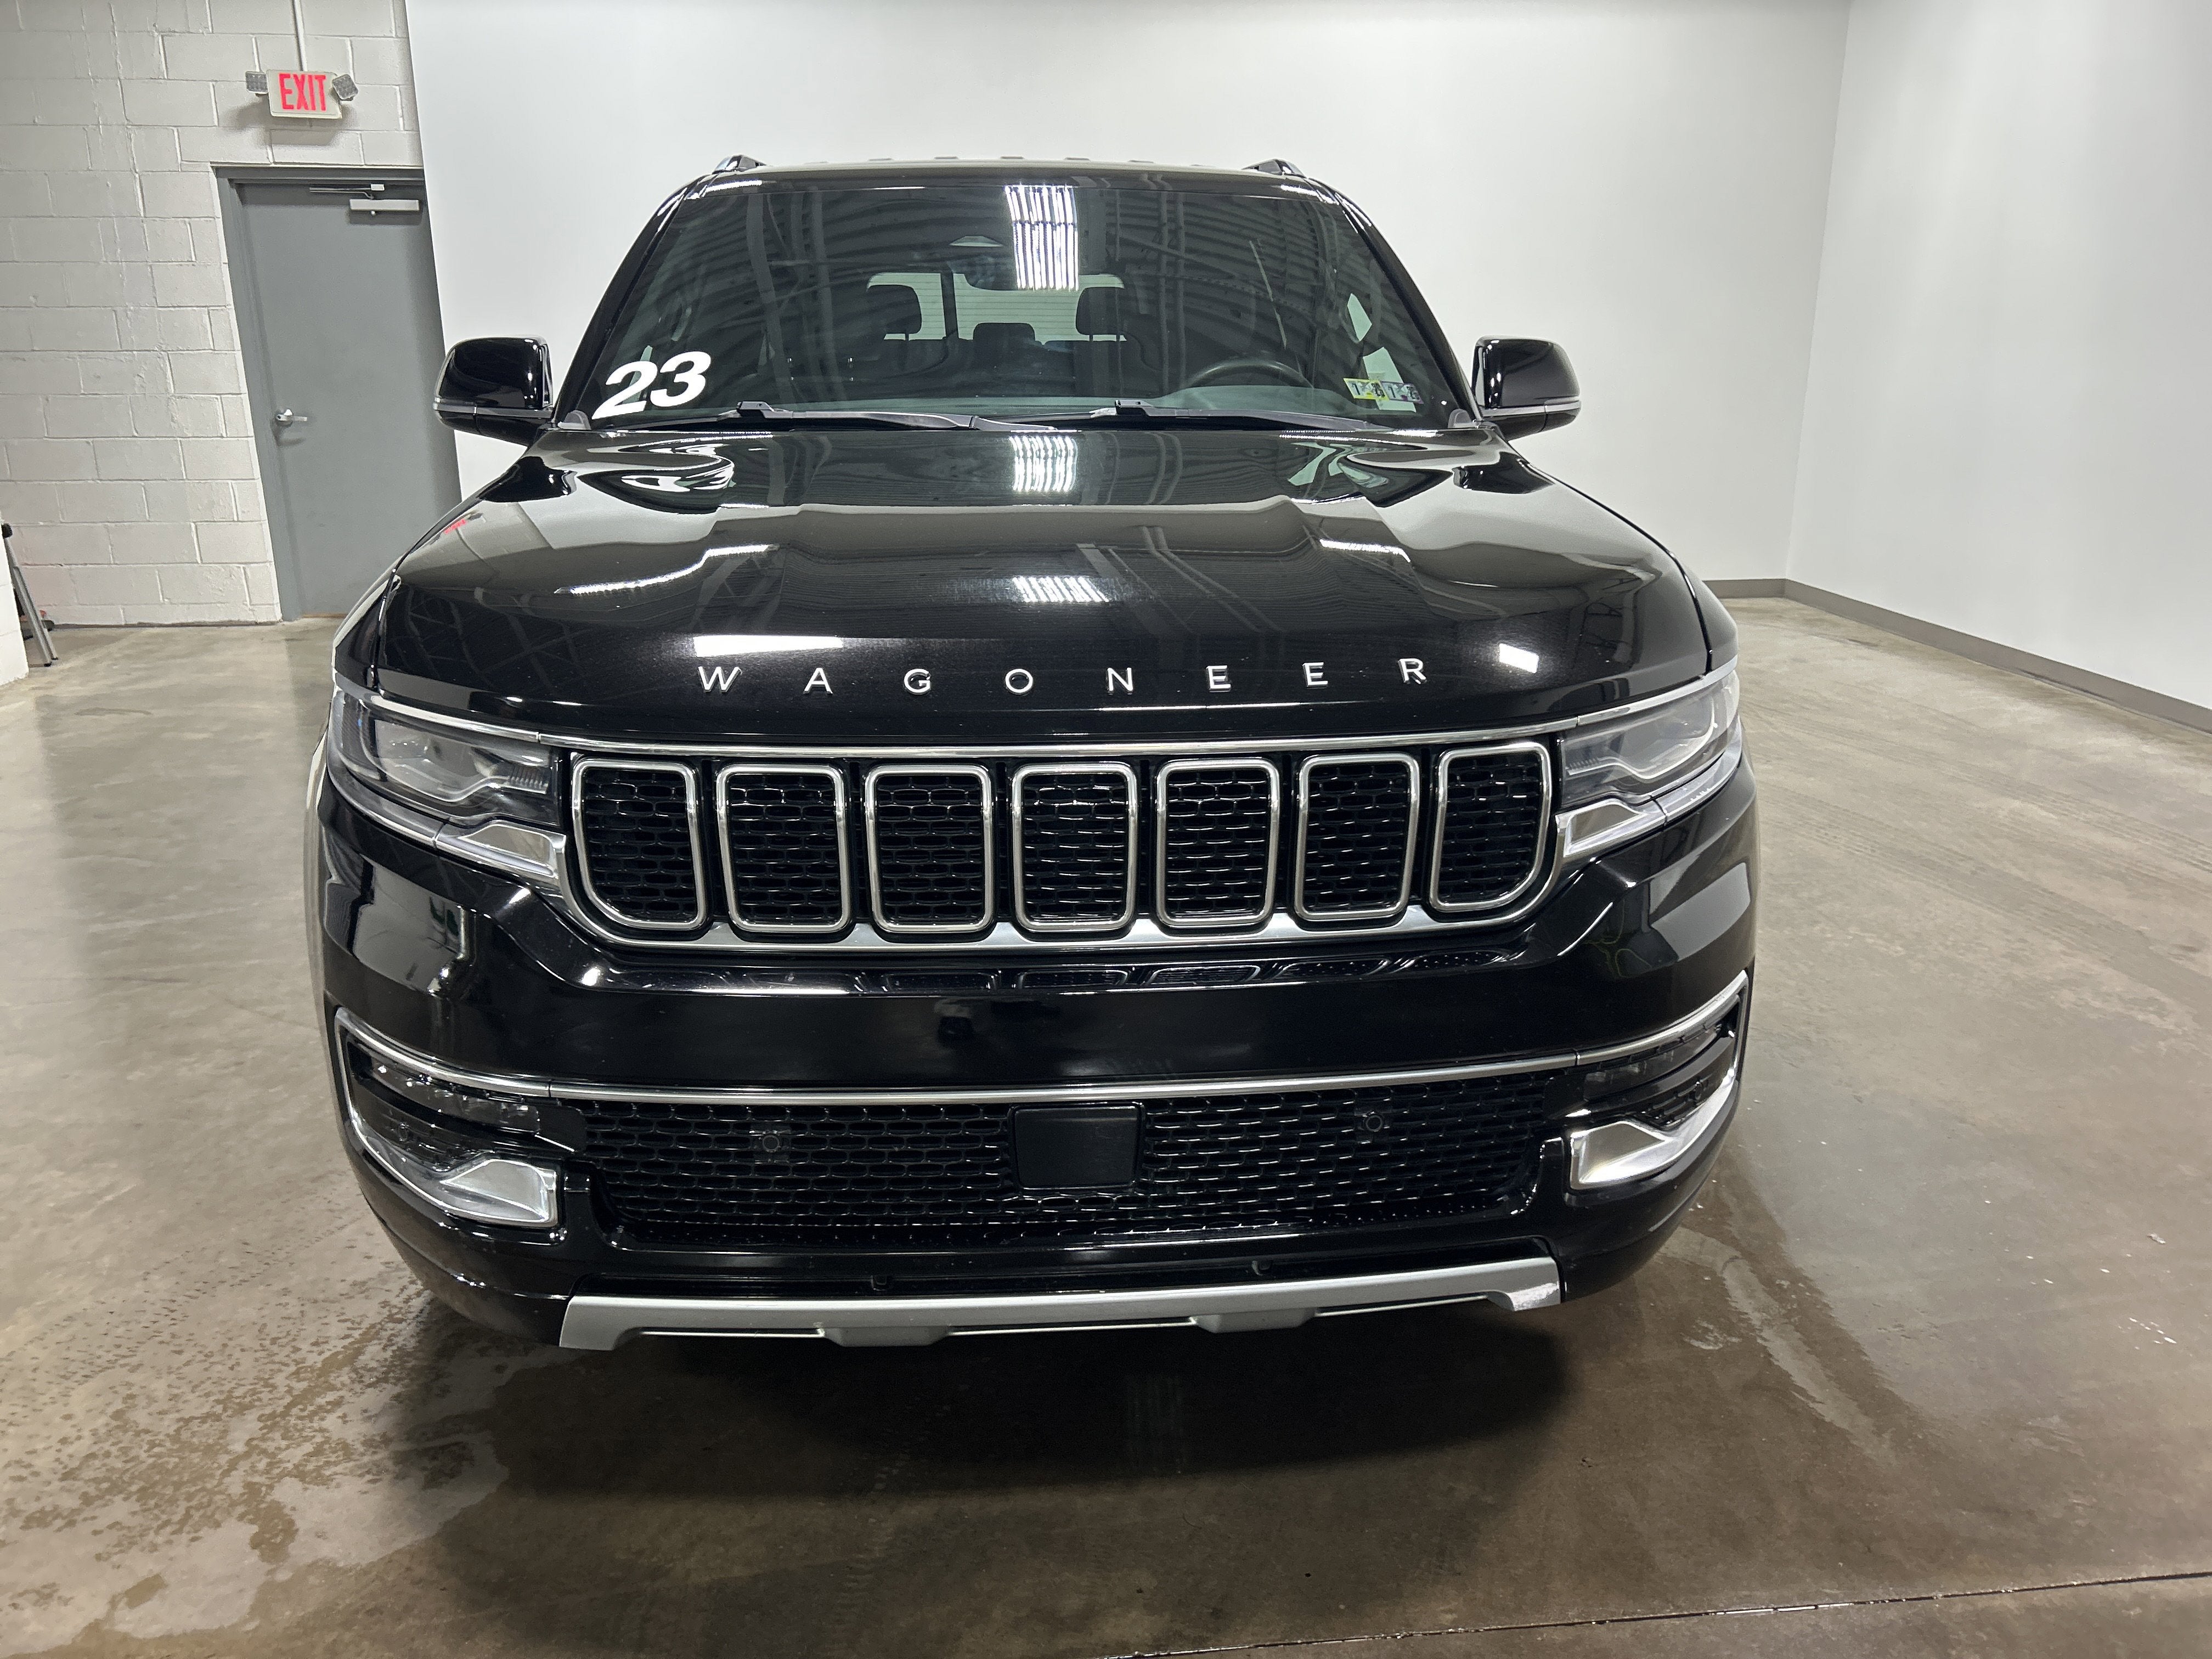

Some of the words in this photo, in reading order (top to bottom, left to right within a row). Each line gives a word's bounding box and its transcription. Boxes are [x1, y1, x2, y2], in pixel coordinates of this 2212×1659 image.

[279, 72, 326, 111] EXIT
[591, 351, 711, 419] 23
[698, 657, 1428, 695] WAGONEER
